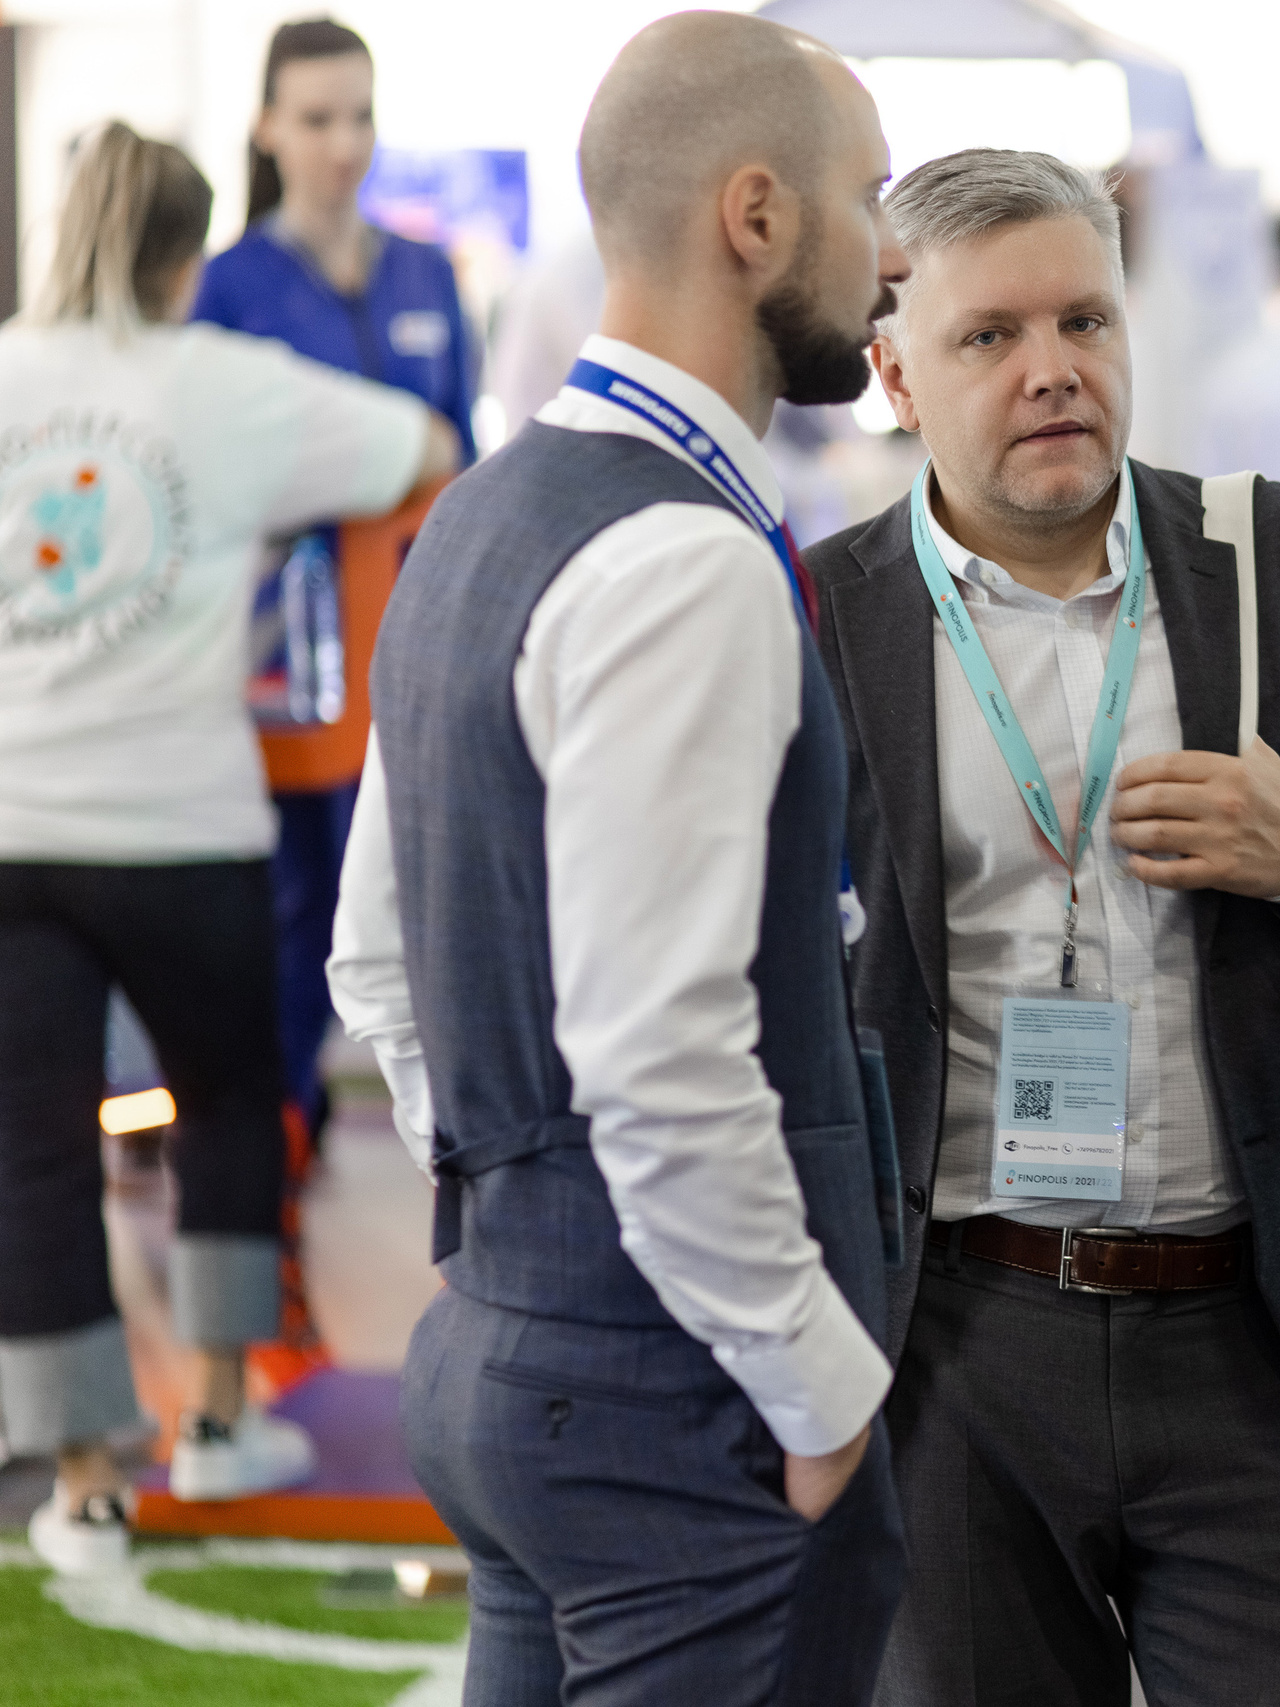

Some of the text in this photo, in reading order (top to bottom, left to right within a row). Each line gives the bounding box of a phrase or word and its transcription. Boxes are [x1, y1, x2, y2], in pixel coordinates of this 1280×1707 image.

[1127, 575, 1141, 619] FINOPOLIS
[945, 601, 968, 643] FINOPOLIS
[1018, 1174, 1068, 1185] FINOPOLIS
